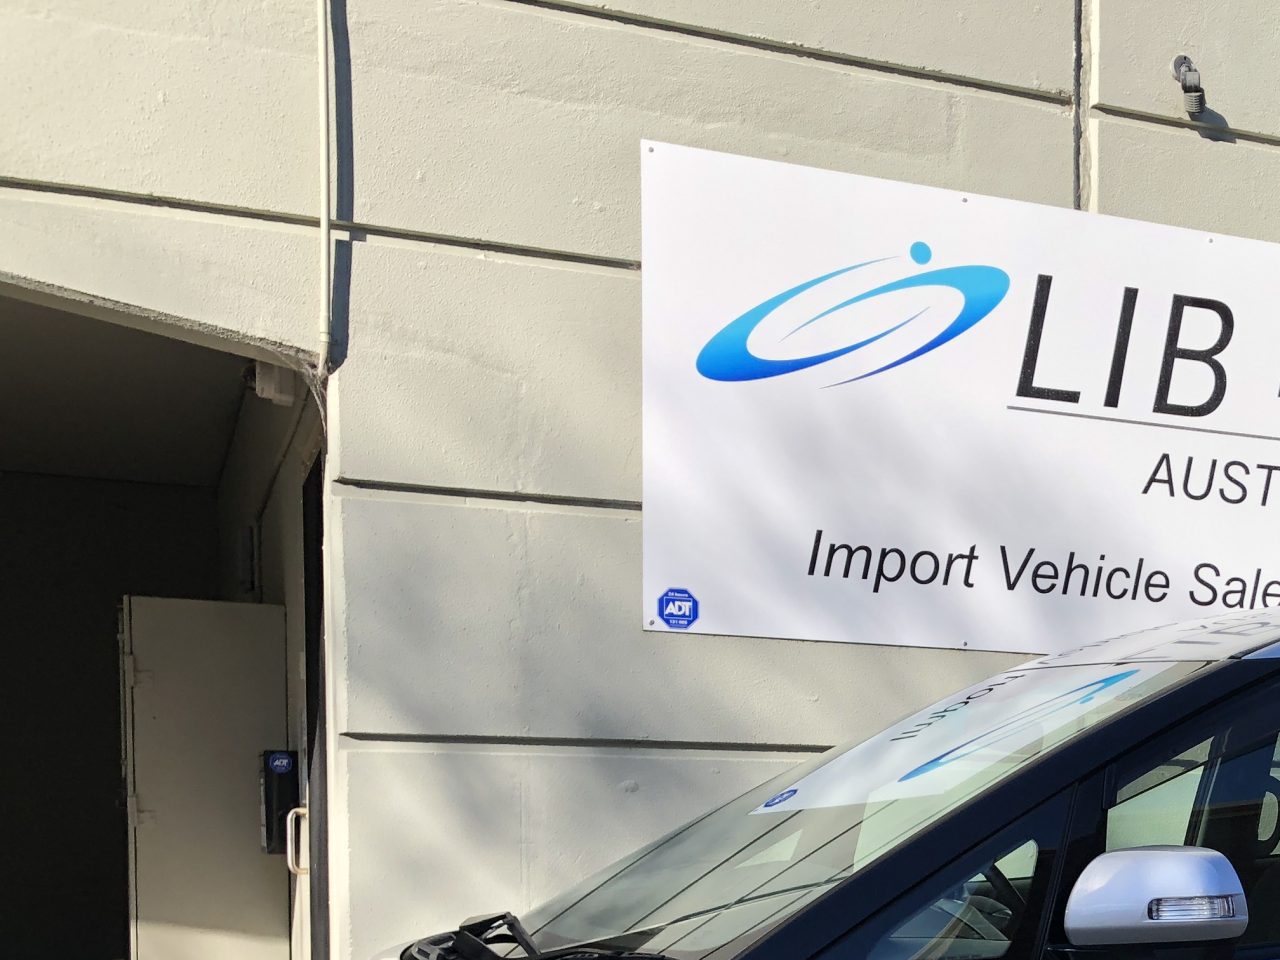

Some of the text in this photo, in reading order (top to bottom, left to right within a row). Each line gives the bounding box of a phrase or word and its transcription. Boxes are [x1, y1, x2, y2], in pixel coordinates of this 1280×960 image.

[1015, 274, 1235, 418] LIB
[807, 529, 979, 594] Import
[999, 545, 1170, 603] Vehicle
[665, 600, 692, 616] ADT
